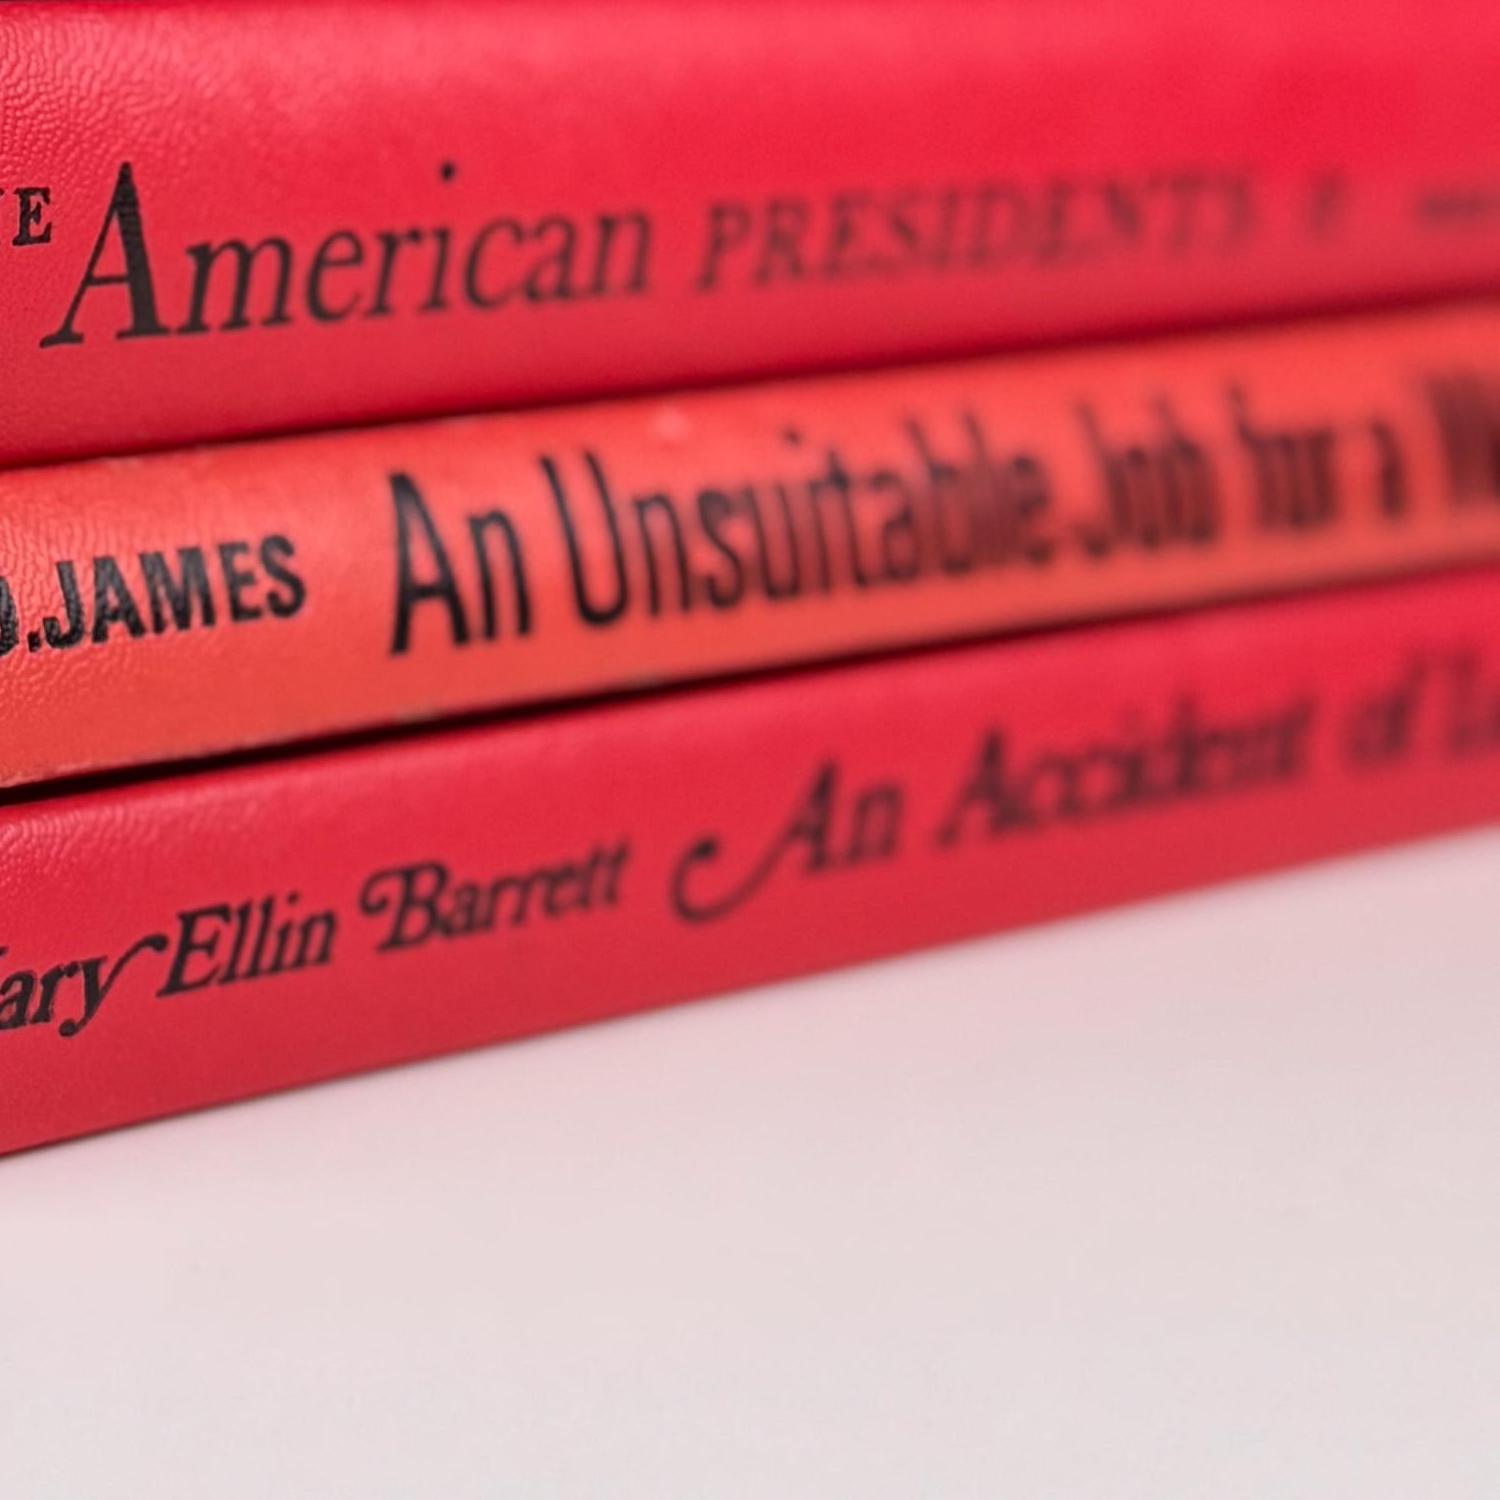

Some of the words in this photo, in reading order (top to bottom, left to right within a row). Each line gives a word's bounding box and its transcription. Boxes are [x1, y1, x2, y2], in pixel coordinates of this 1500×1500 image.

[38, 160, 655, 350] American
[388, 470, 532, 658] An
[538, 405, 1056, 628] Unsuitable
[155, 890, 342, 999] Ellin
[361, 837, 632, 955] Barrett
[670, 758, 905, 925] An
